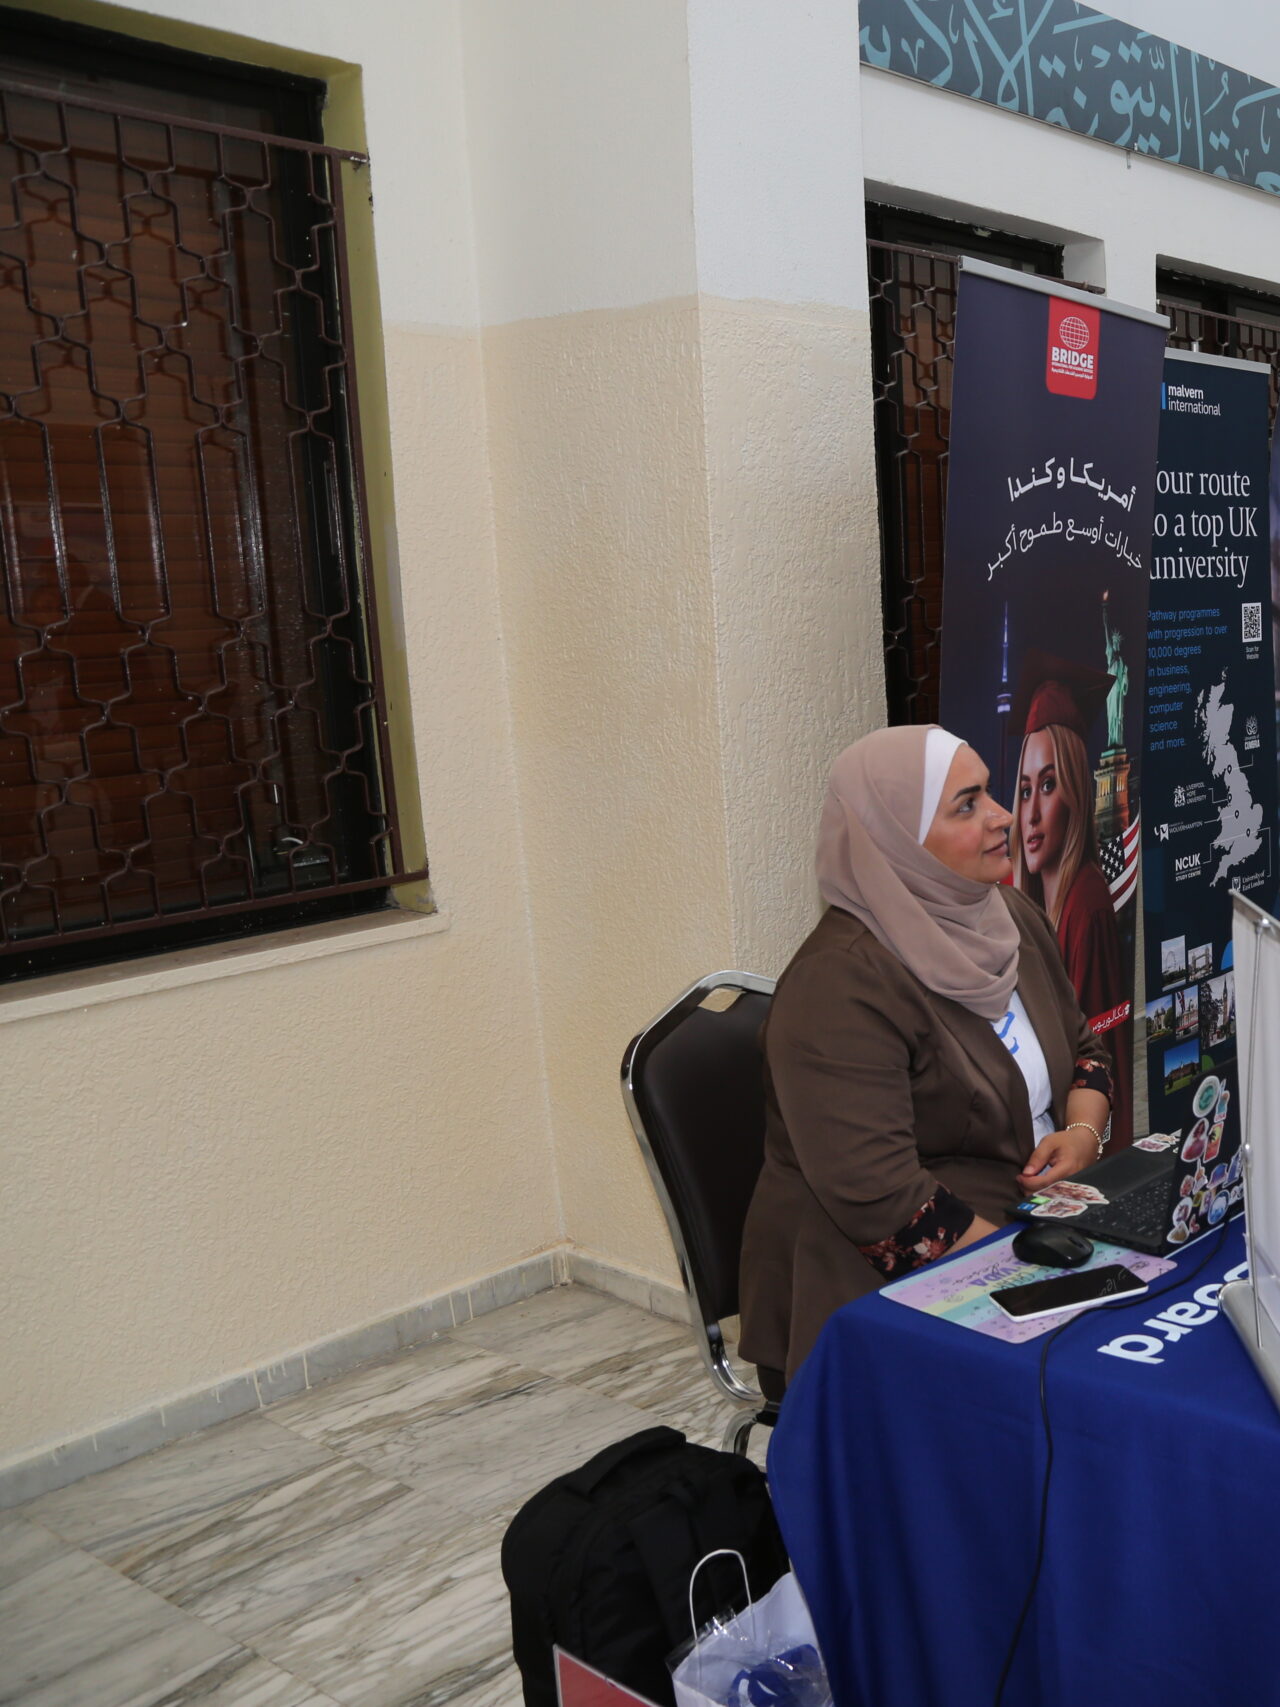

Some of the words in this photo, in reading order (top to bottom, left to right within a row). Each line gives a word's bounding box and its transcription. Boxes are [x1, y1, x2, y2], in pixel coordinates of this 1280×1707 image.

[1052, 347, 1094, 368] BRIDGE
[1168, 385, 1203, 399] malvern
[1169, 398, 1220, 416] international
[1070, 457, 1136, 512] أمريكا
[1156, 467, 1194, 494] our
[1200, 471, 1250, 497] route
[1020, 512, 1063, 552] طموح
[1066, 516, 1104, 544] أوسع
[1152, 513, 1167, 536] o
[1174, 513, 1186, 536] a
[1191, 510, 1223, 547] top
[1228, 507, 1258, 537] UK
[988, 524, 1016, 581] أكبر
[1105, 531, 1142, 568] خيارات
[1150, 547, 1249, 588] university
[1180, 608, 1220, 621] programmes
[1148, 630, 1163, 640] with
[1164, 627, 1204, 641] progression
[1206, 626, 1213, 635] to
[1214, 626, 1227, 634] over
[1148, 647, 1172, 658] 10,000
[1174, 645, 1201, 658] degrees
[1148, 667, 1155, 677] in
[1157, 665, 1189, 676] business,
[1149, 682, 1192, 697] engineering,
[1149, 701, 1183, 715] computer
[1149, 721, 1177, 732] science
[1151, 740, 1164, 751] and
[1175, 853, 1200, 872] NCUK
[1176, 873, 1187, 882] STUDY
